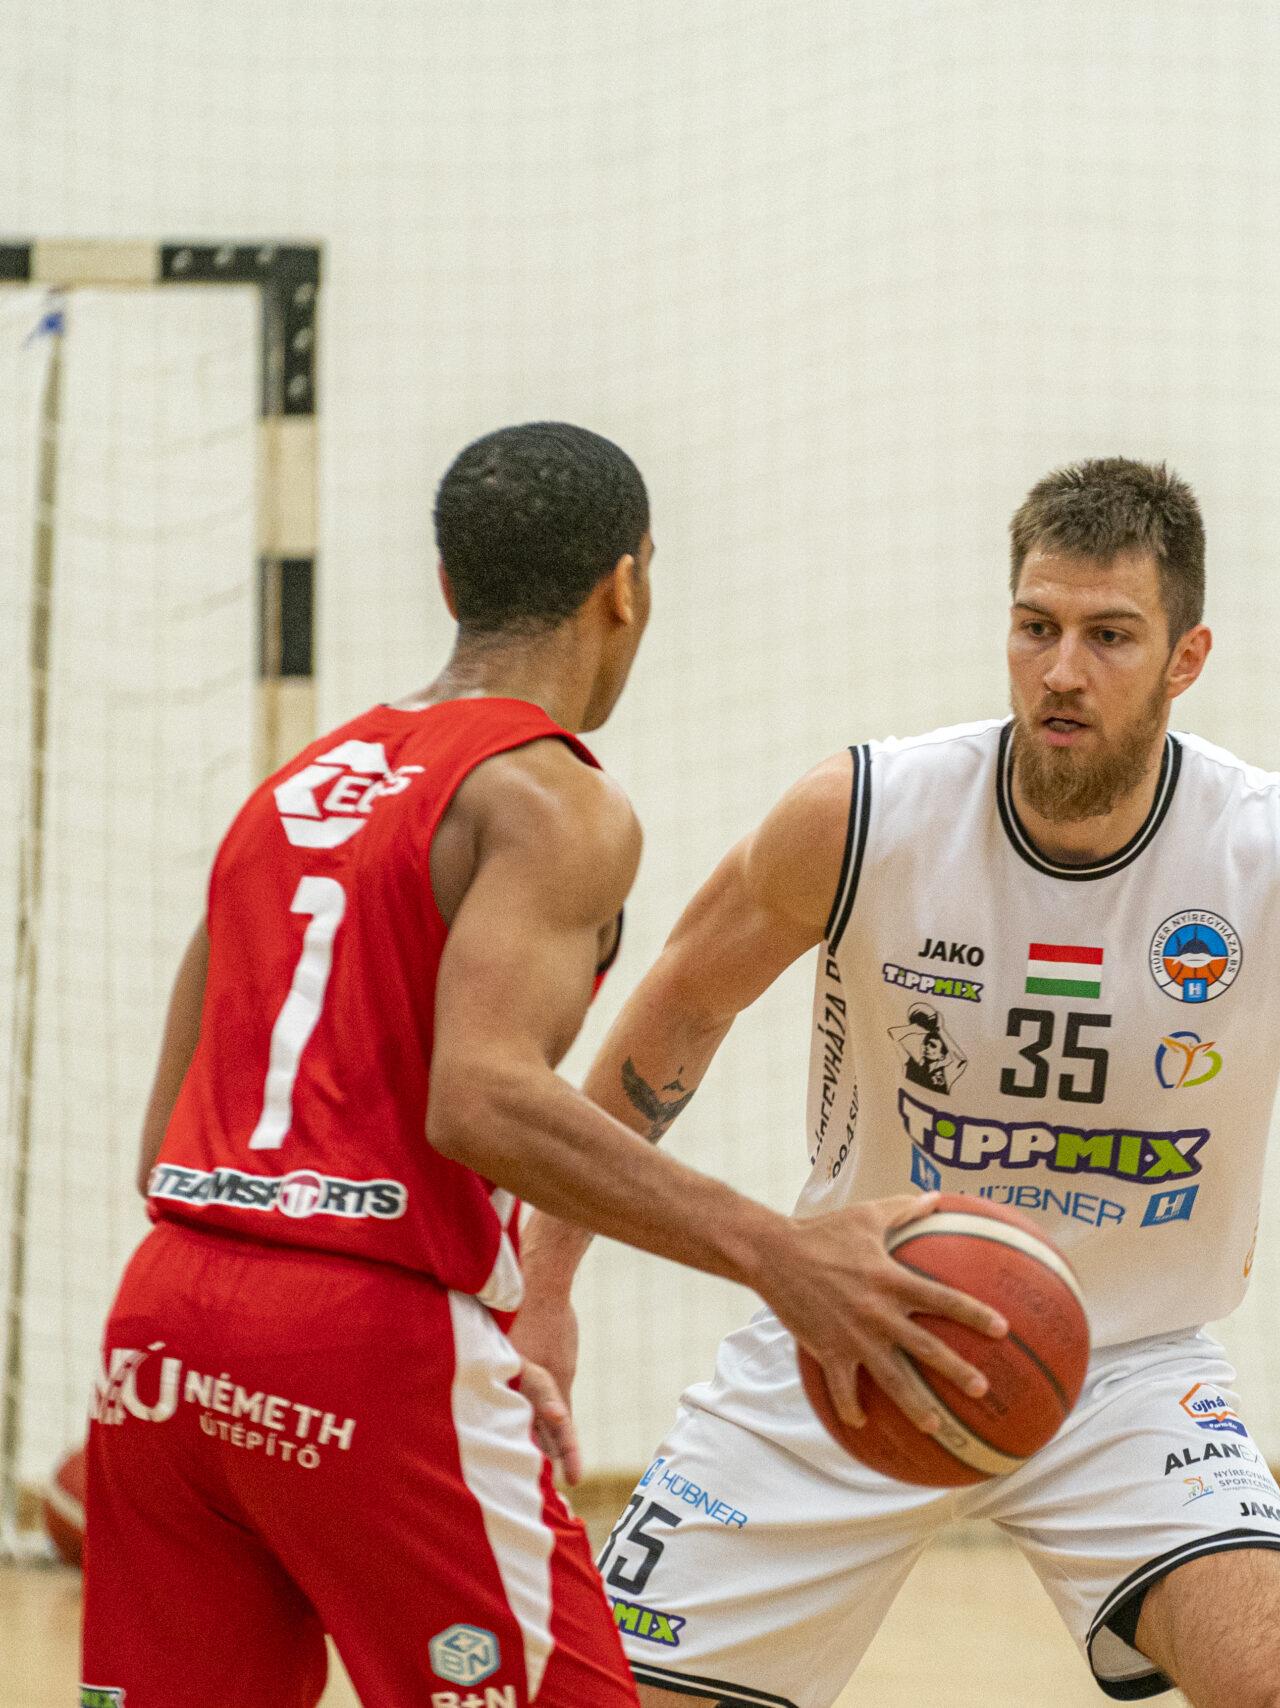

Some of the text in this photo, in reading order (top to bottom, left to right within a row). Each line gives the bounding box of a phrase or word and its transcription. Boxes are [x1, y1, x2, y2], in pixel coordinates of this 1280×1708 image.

[918, 938, 984, 967] JAKO
[248, 876, 346, 1149] 1
[1001, 1007, 1112, 1105] 35
[184, 1370, 356, 1450] NÉMETH
[1192, 1396, 1228, 1413] újhá
[657, 1468, 748, 1530] HÜBNER
